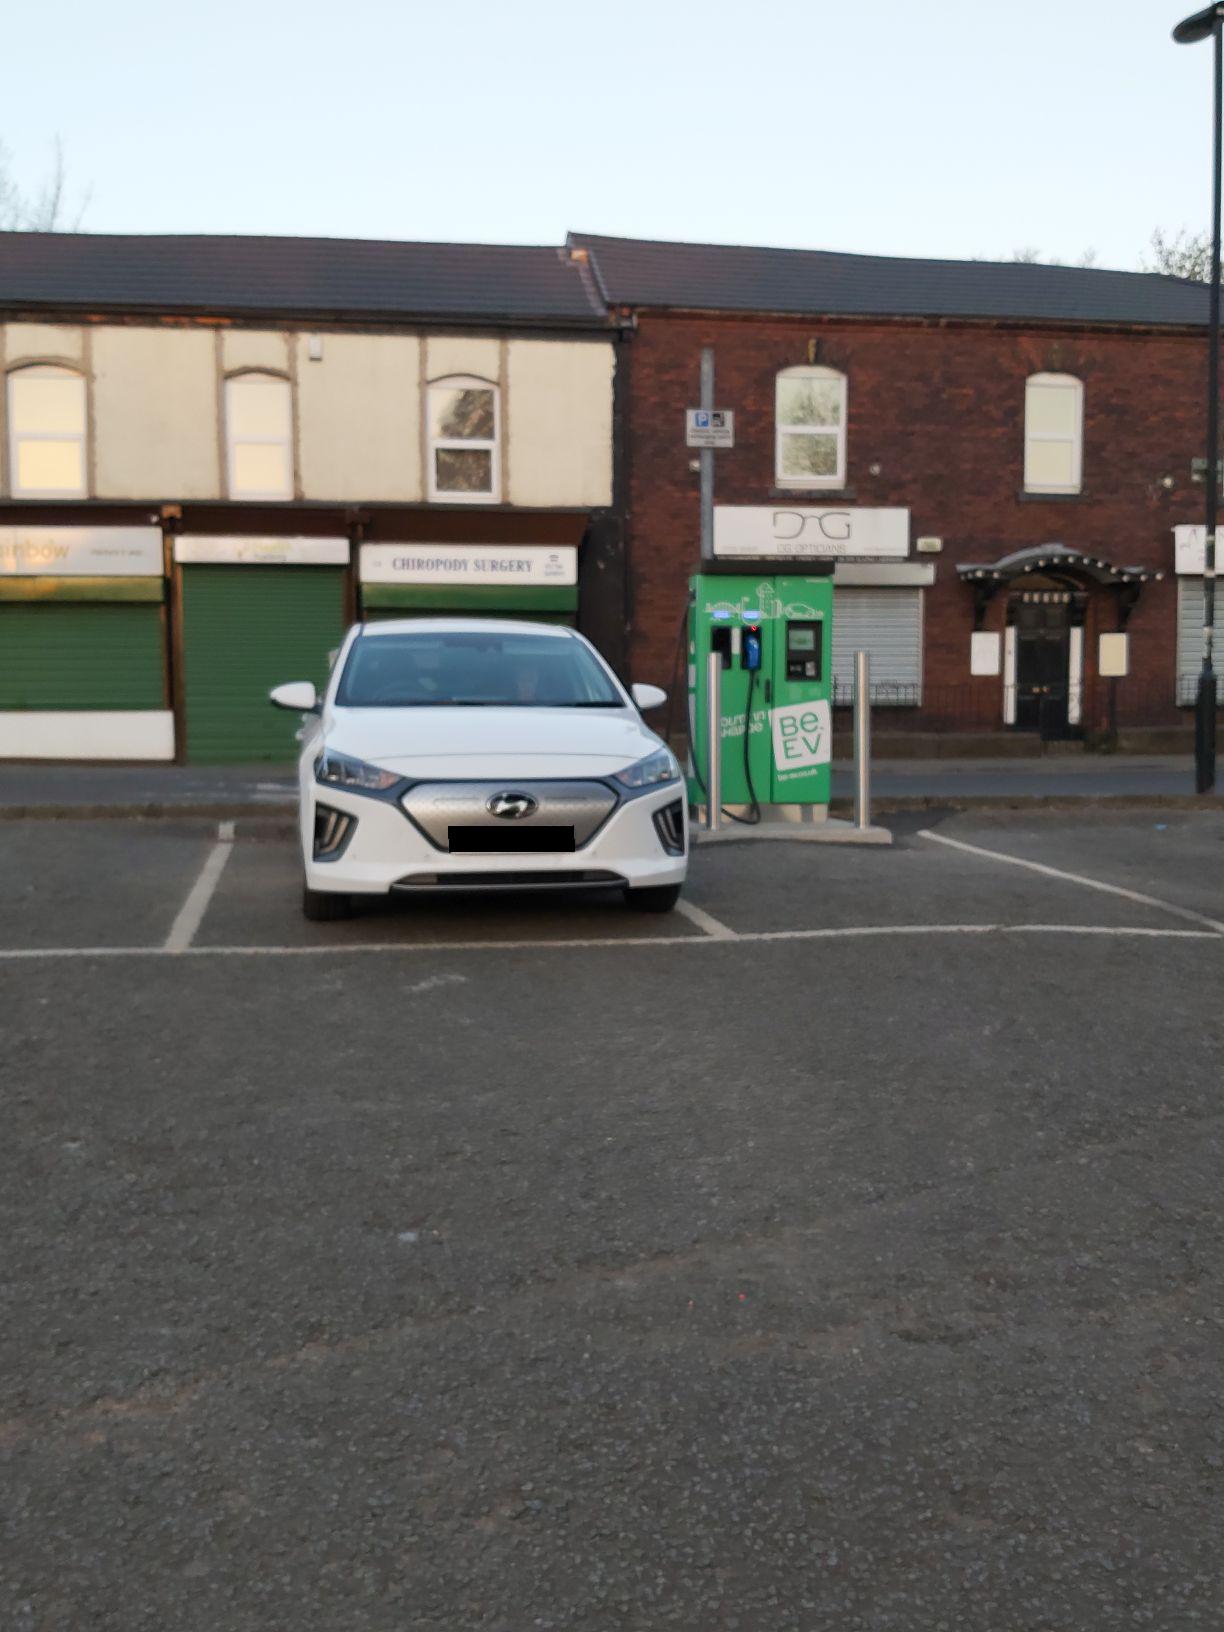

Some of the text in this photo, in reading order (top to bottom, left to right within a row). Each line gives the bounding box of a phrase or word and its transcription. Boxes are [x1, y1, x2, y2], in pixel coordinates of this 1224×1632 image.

[0, 537, 70, 559] inbow
[795, 543, 847, 555] OPTICIANS
[392, 557, 469, 572] CHIROPODY
[473, 558, 533, 573] SURGERY
[783, 734, 822, 759] EV
